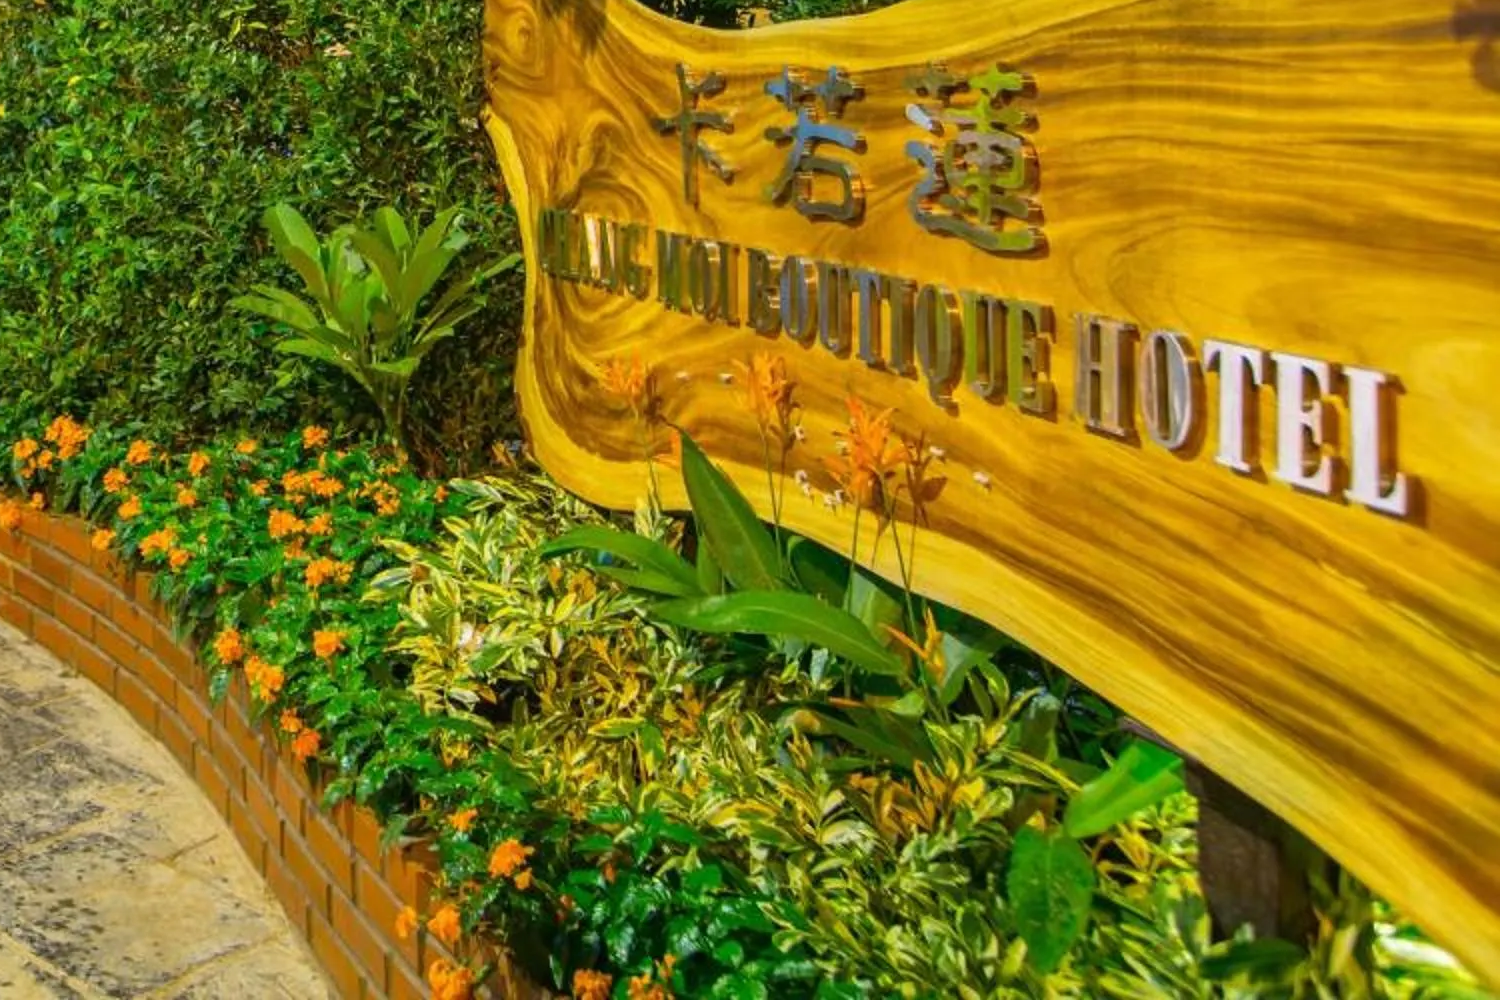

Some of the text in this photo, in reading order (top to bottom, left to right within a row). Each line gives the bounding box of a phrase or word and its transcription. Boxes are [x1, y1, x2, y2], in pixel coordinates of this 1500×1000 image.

[656, 229, 741, 329] MOI
[746, 248, 1057, 422] BOUTIQUE
[1073, 313, 1414, 518] HOTEL
